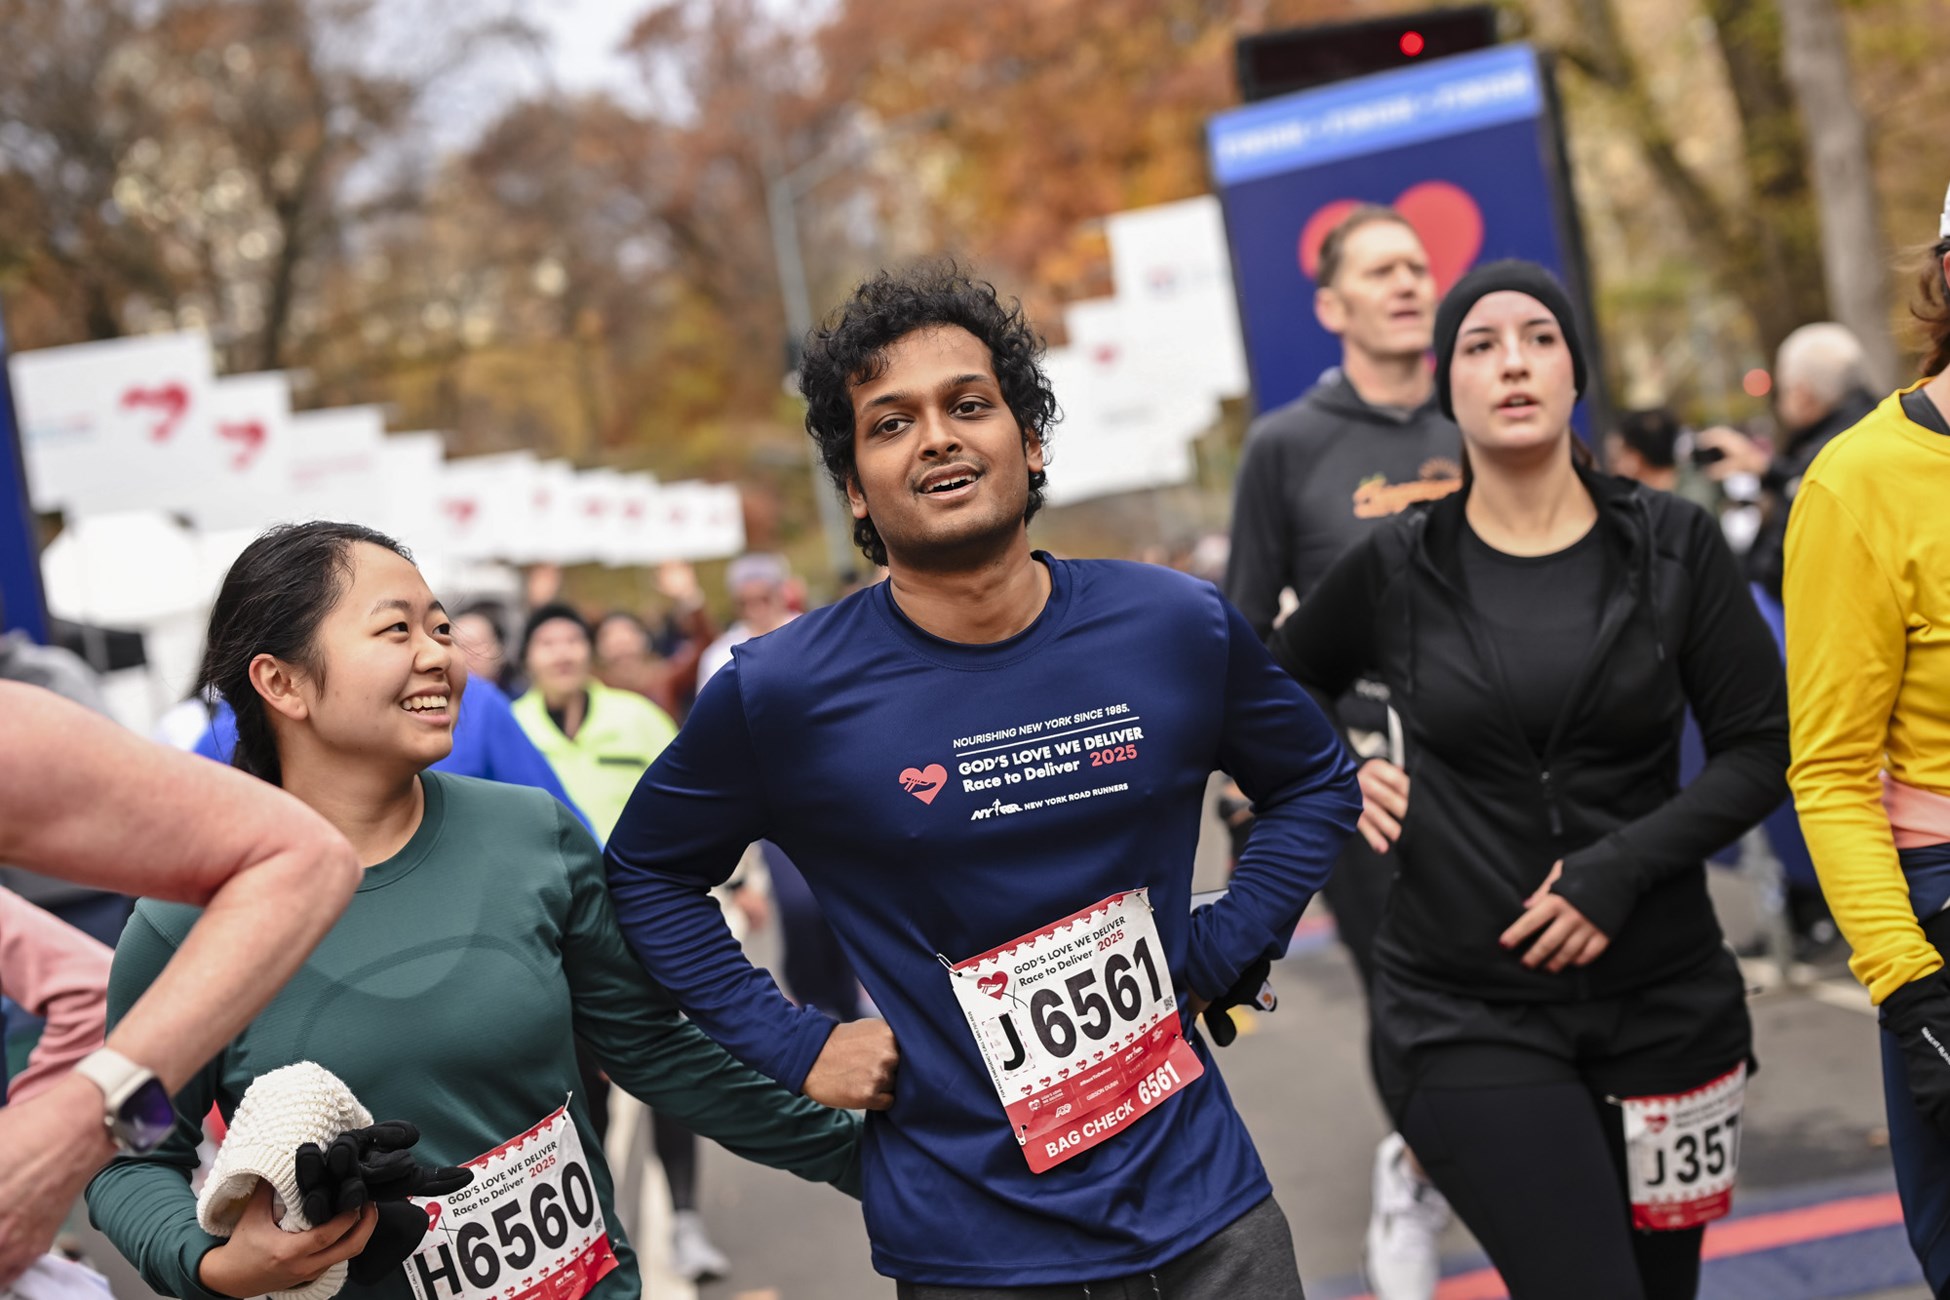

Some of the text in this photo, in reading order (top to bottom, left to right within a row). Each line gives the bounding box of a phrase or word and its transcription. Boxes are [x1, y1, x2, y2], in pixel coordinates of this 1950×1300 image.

[953, 703, 1130, 749] NOURISHING NEW YORK SINCE 1985.
[958, 726, 1144, 776] GOD'S LOVE WE DELIVER
[963, 744, 1138, 793] Race to Deliver 2025
[1024, 800, 1044, 811] NEW
[1044, 795, 1067, 807] YORK
[1068, 790, 1091, 801] ROAD
[1092, 783, 1129, 798] RUNNERS
[1014, 916, 1126, 975] GOD'S LOVE WE DELIVER
[1019, 929, 1125, 987] Race to Deliver 2025
[1044, 1130, 1082, 1158] BAG
[1082, 1098, 1136, 1138] CHECK
[1137, 1060, 1181, 1105] 6561
[447, 1141, 558, 1205] GOD'S LOVE WE DELIVER
[452, 1154, 556, 1218] Race to Deliver 2025
